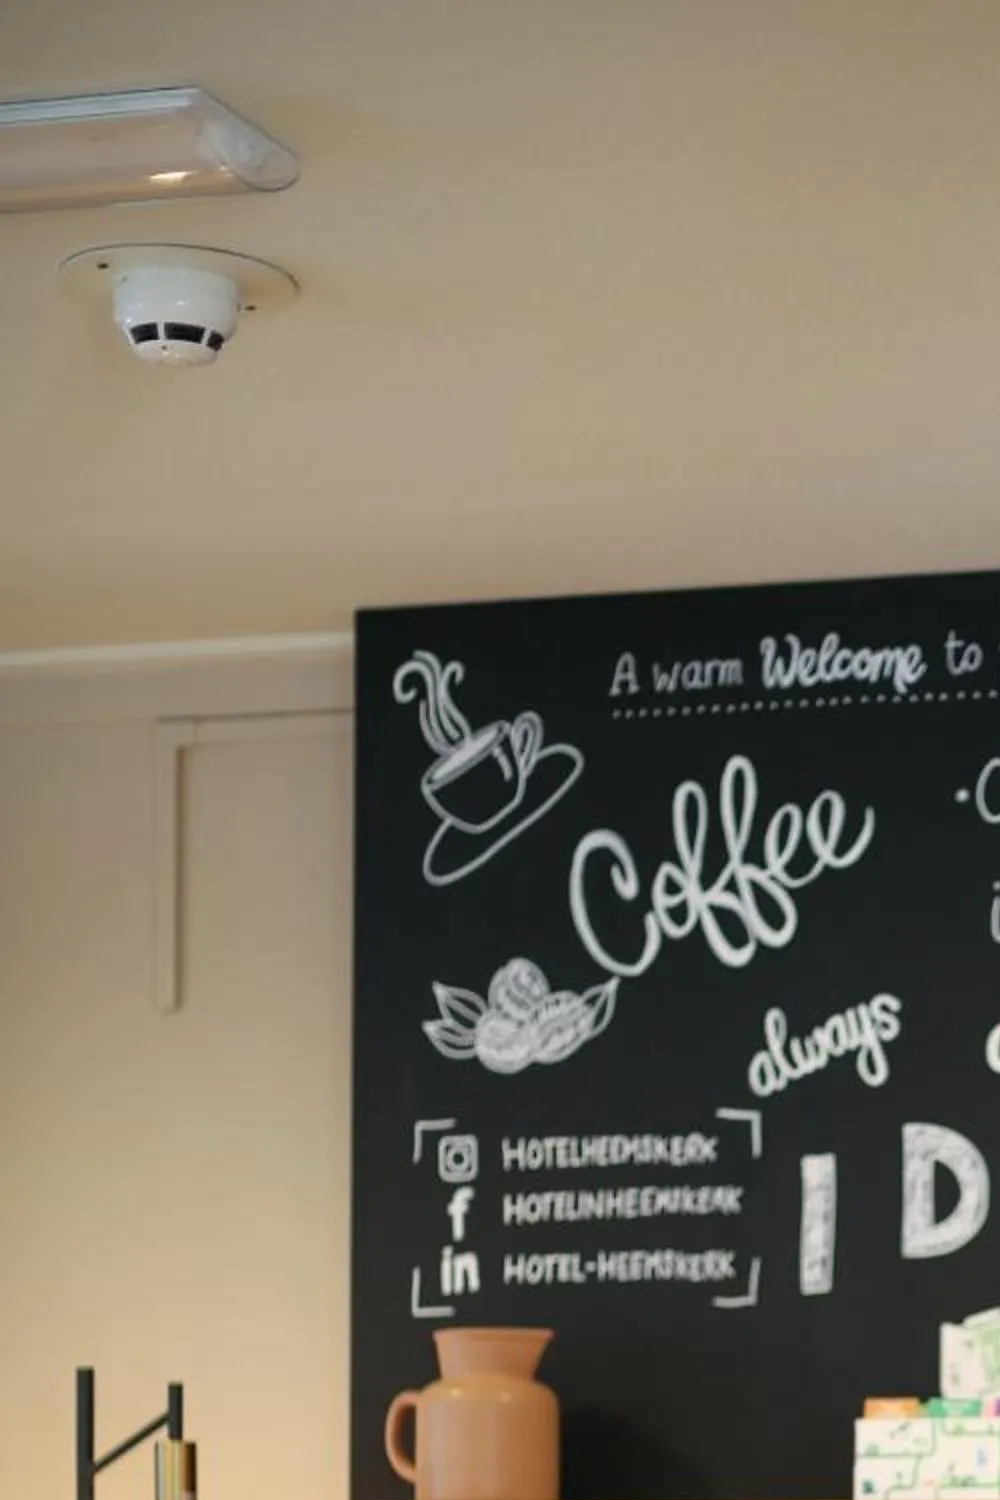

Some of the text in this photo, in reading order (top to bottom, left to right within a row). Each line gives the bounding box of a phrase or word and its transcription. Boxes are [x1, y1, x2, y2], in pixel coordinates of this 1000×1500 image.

[609, 652, 640, 697] A
[653, 658, 744, 693] warm
[760, 632, 929, 694] Welcome
[944, 631, 983, 676] to
[569, 755, 875, 976] Coffee
[747, 993, 902, 1097] always
[439, 1245, 481, 1297] in
